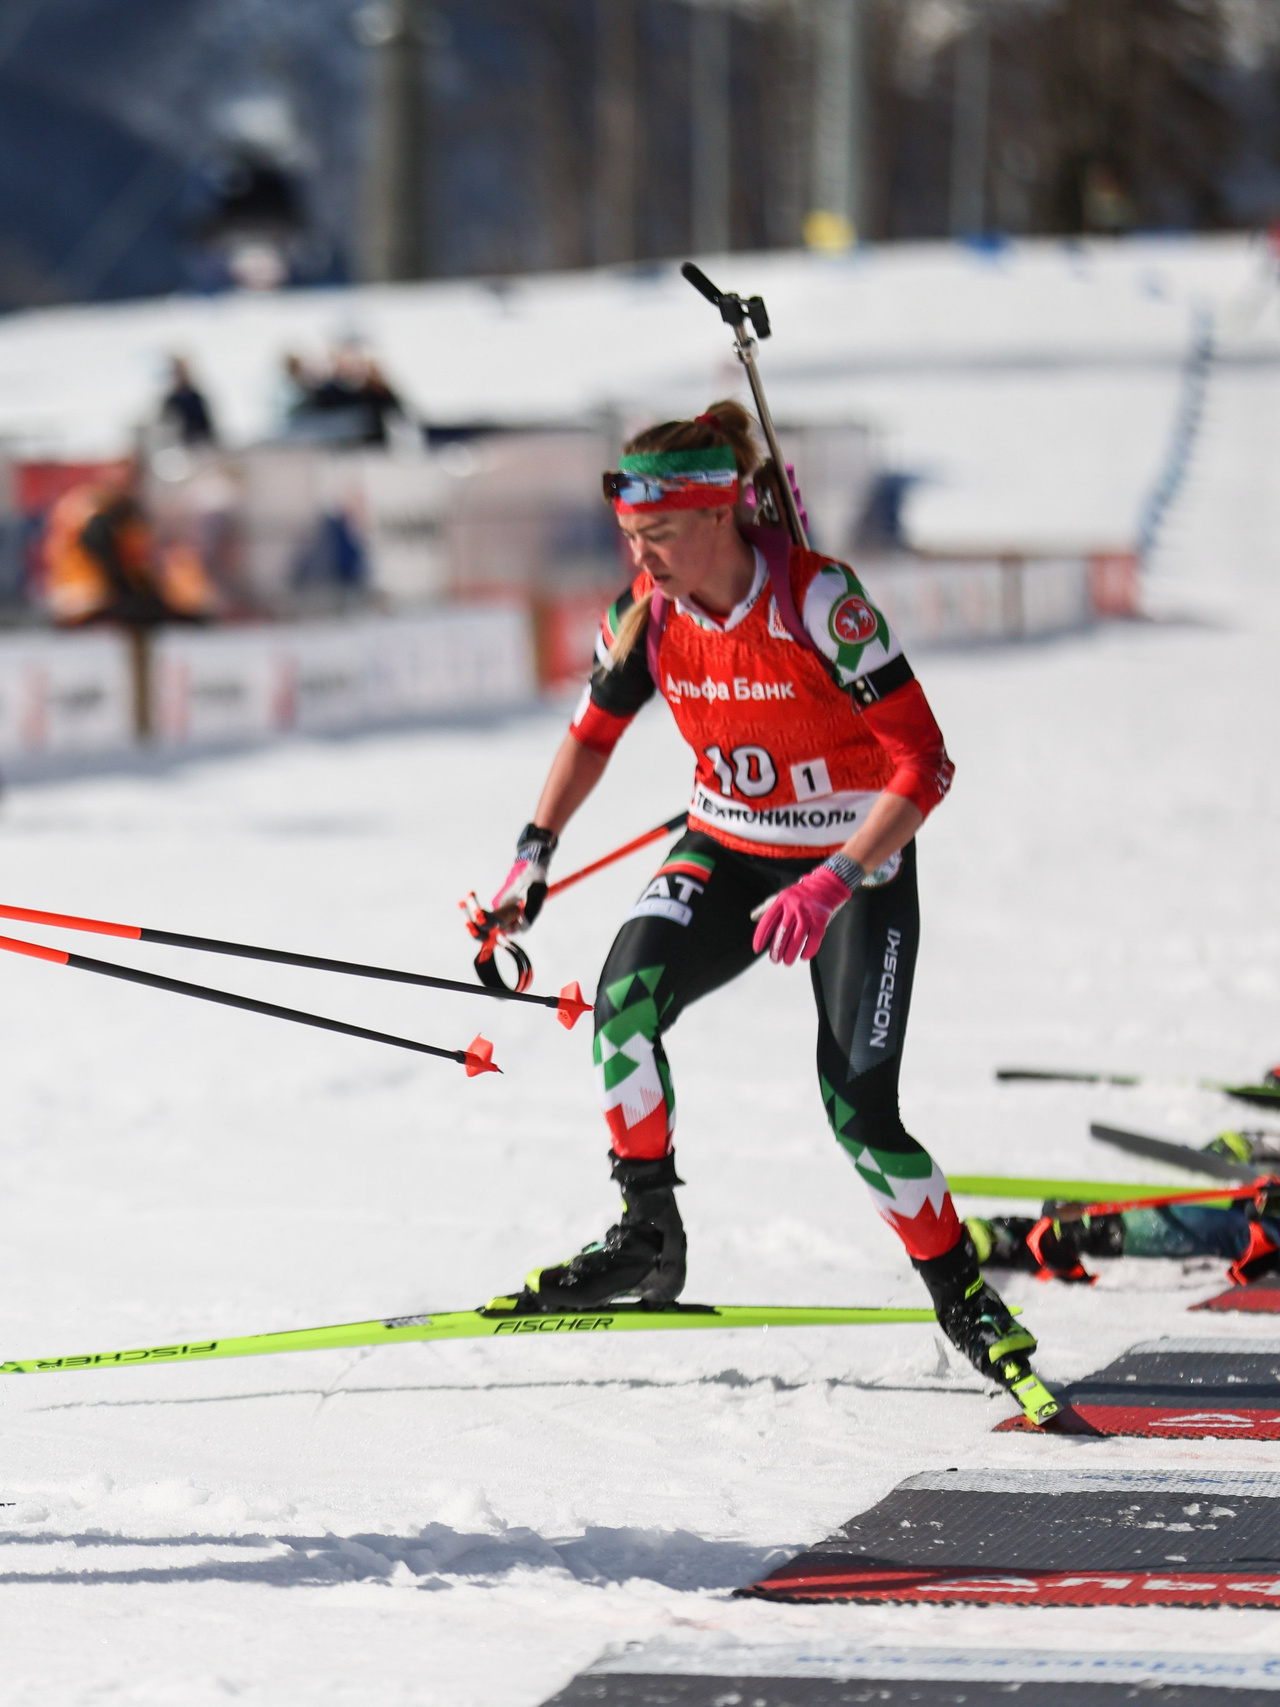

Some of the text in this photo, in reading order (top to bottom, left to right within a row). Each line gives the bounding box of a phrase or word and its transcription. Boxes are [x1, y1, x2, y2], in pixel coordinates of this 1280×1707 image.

[666, 674, 796, 704] Альфа Банк
[705, 746, 778, 798] 10
[802, 766, 816, 793] 1
[868, 927, 902, 1048] NORDSKI
[493, 1316, 614, 1335] FISCHER
[35, 1341, 218, 1369] FISCHER
